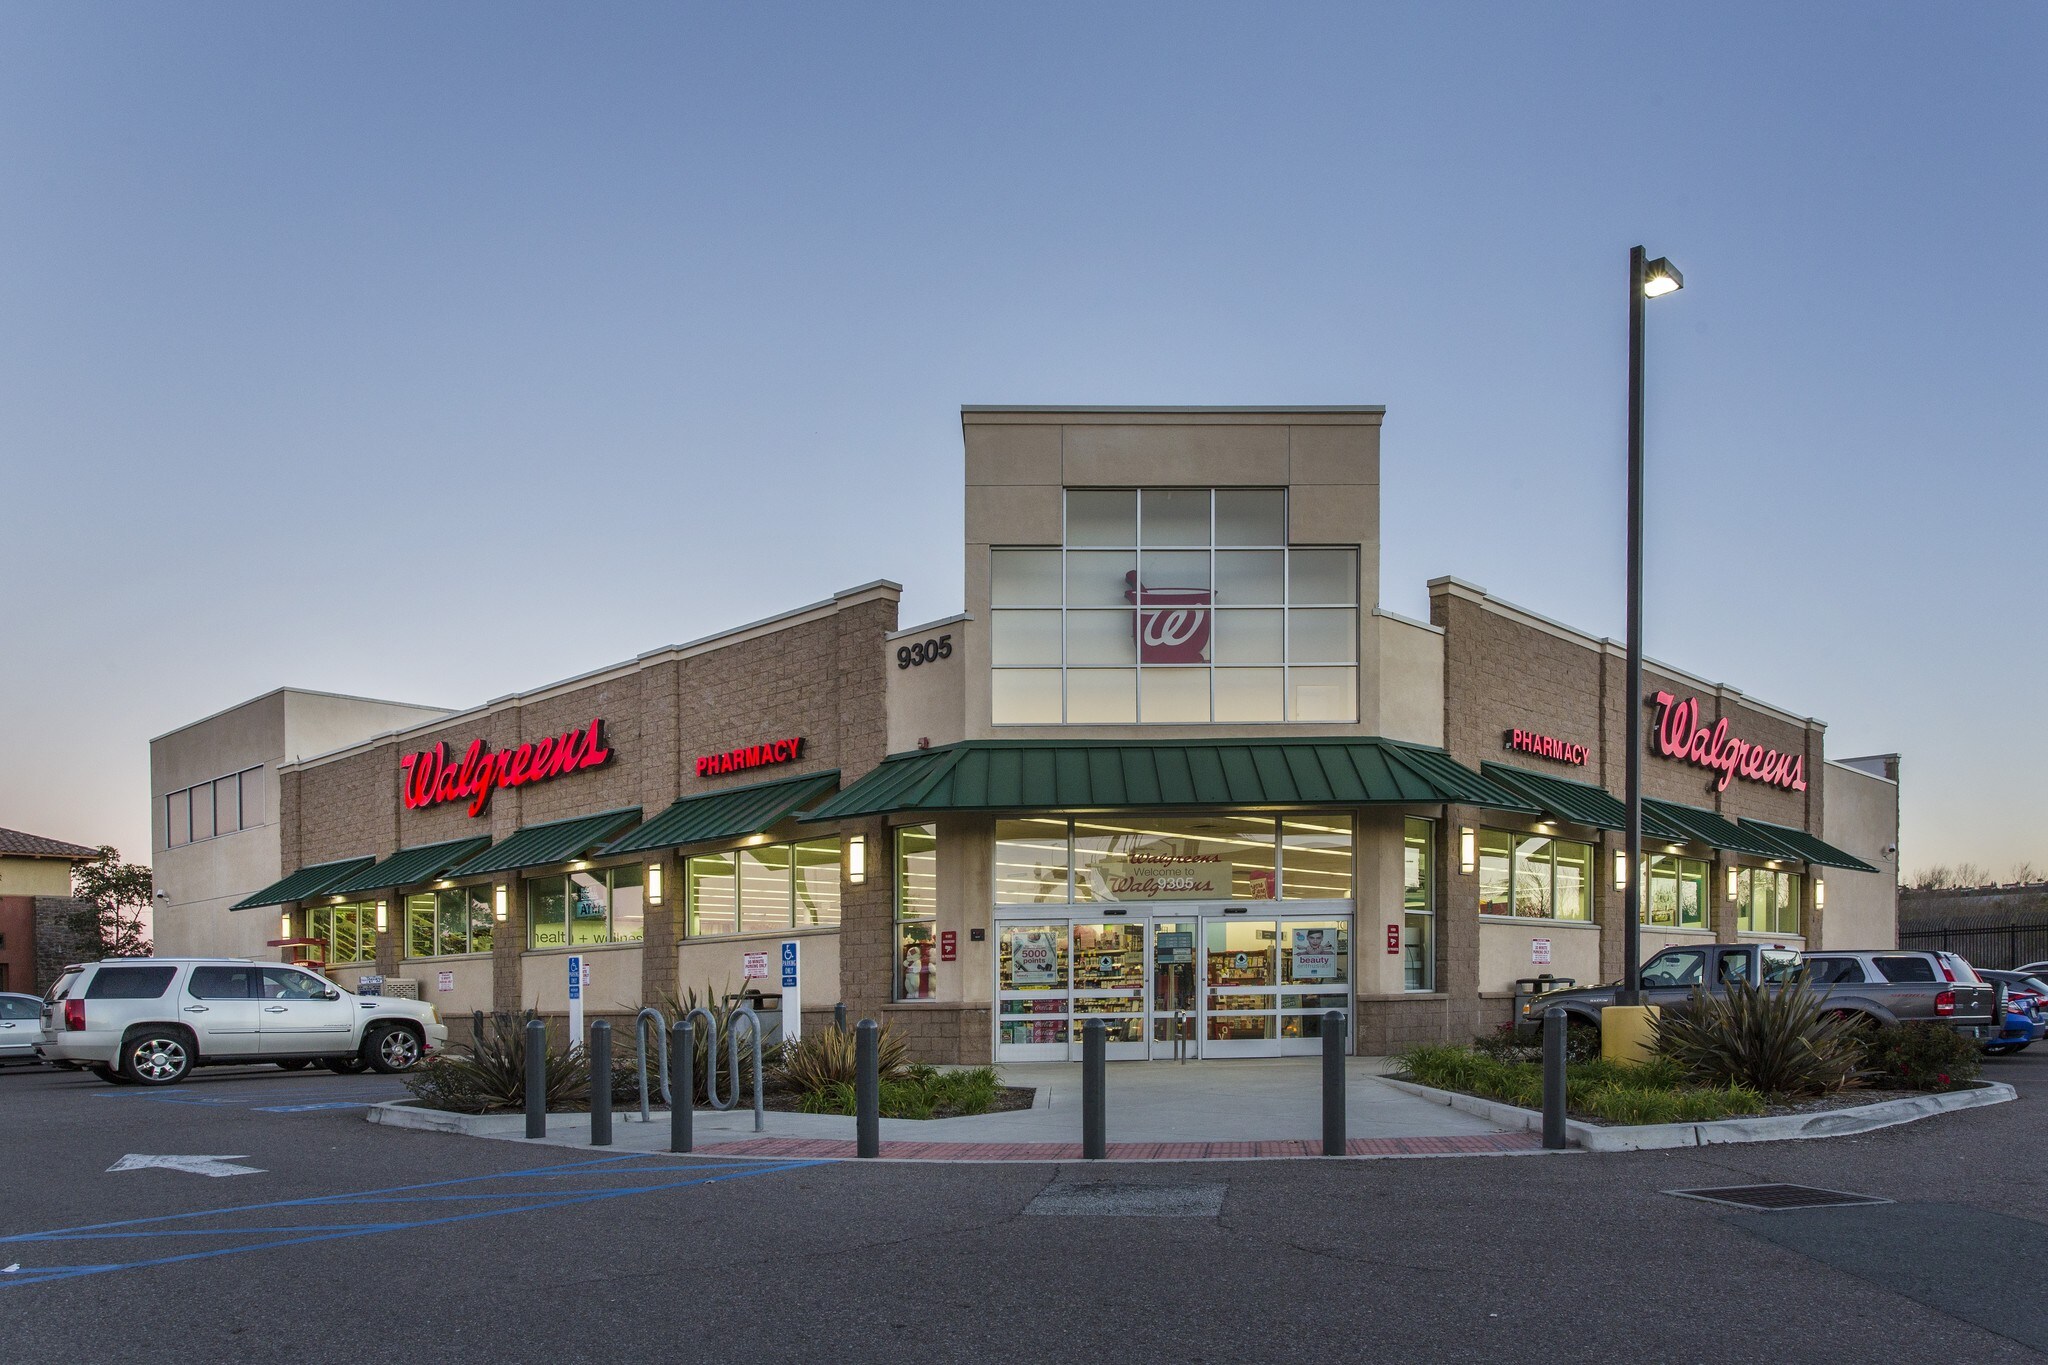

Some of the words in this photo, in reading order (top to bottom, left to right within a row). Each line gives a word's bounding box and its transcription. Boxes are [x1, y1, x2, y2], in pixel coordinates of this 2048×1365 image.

[897, 634, 952, 670] 9305
[1512, 728, 1590, 766] PHARMACY
[1656, 690, 1807, 792] Walgreens
[696, 737, 802, 777] PHARMACY
[401, 718, 609, 818] Walgreens
[1129, 853, 1222, 867] Walgreens
[1133, 867, 1182, 877] Welcome
[1184, 867, 1195, 876] to
[1157, 877, 1194, 889] 9305
[535, 930, 574, 943] ealt
[1022, 949, 1047, 958] 5000
[1300, 956, 1329, 965] beauty
